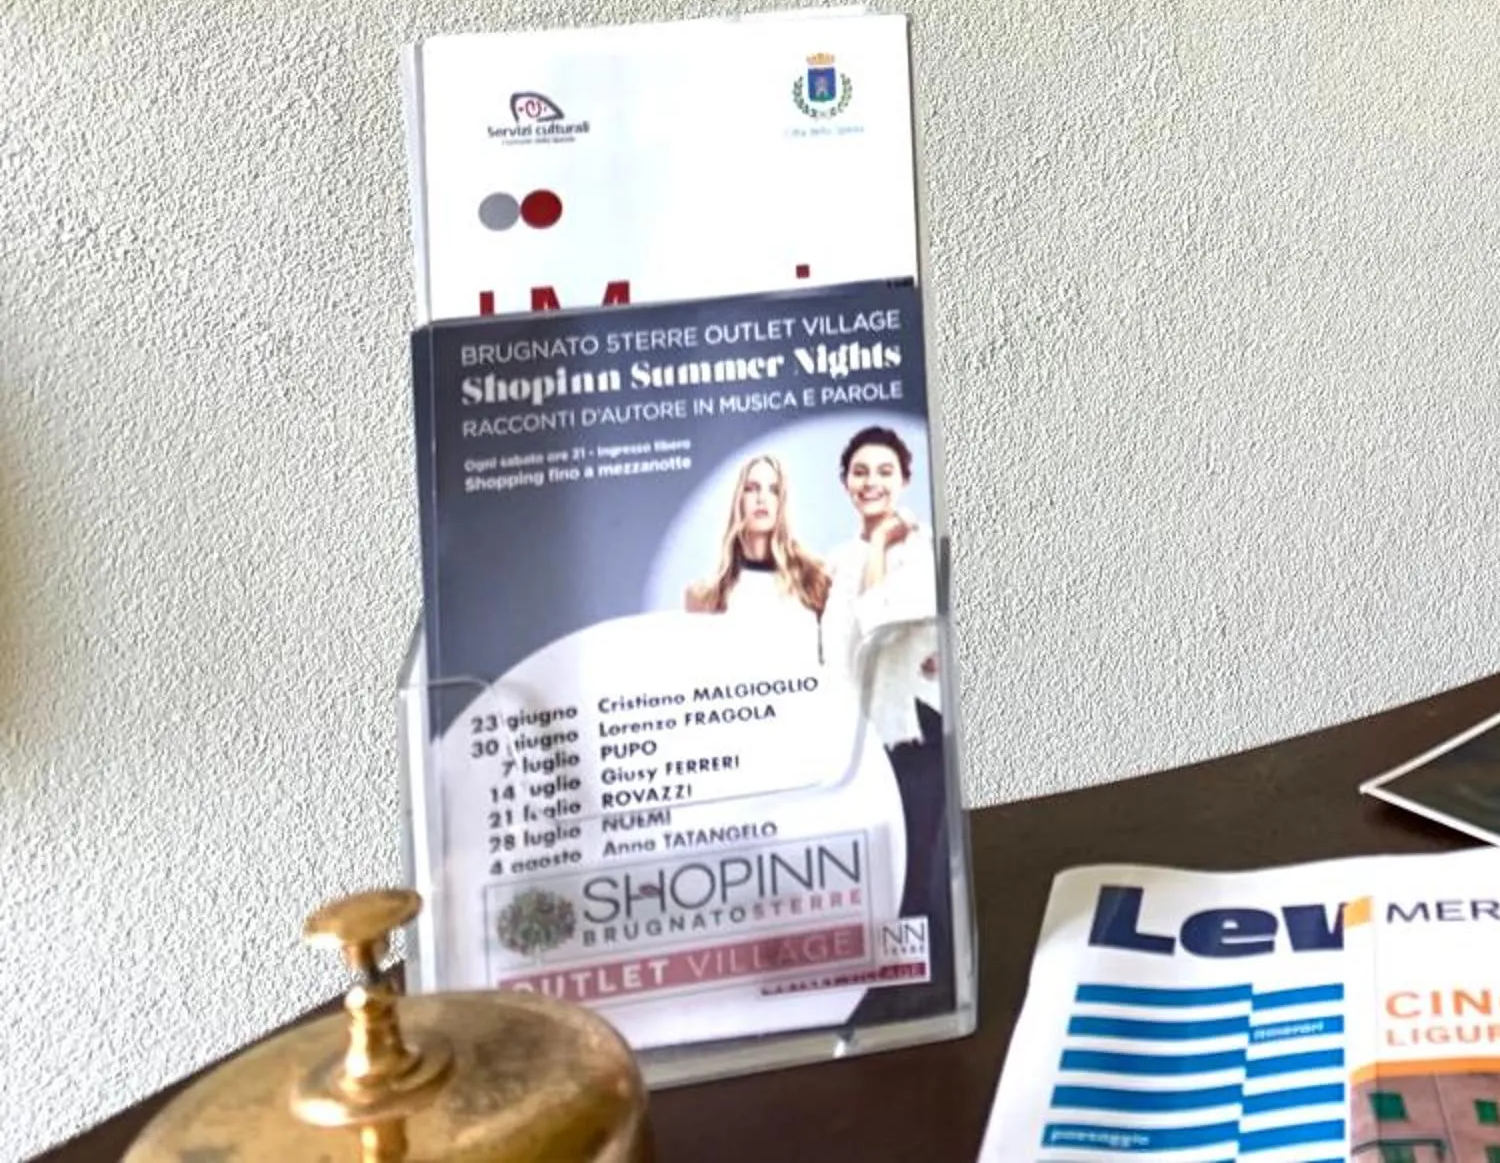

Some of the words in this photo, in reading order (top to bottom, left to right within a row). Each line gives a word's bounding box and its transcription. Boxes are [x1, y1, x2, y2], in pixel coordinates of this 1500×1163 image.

[461, 334, 599, 367] BRUGNATO
[607, 326, 698, 353] 5TERRE
[705, 317, 796, 345] OUTLET
[802, 309, 901, 337] VILLAGE
[461, 366, 621, 405] Shopinn
[630, 354, 785, 389] Summer
[794, 341, 902, 380] Nights
[463, 409, 575, 438] RACCONTI
[582, 399, 688, 427] D'AUTORE
[693, 396, 715, 416] IN
[720, 389, 798, 414] MUSICA
[803, 388, 816, 407] E
[821, 380, 903, 405] PAROLE
[547, 449, 569, 463] ore
[464, 470, 544, 494] Shopping
[548, 466, 580, 483] fino
[584, 467, 594, 479] a
[598, 456, 692, 477] mezzanotte
[598, 692, 686, 714] Cristiano
[693, 676, 819, 703] MALGIOGLIO
[471, 714, 499, 735] 23
[506, 706, 578, 731] giugno
[598, 718, 677, 738] Lorenzo
[684, 704, 776, 727] FRAGOLA
[471, 738, 499, 759] 30
[600, 739, 657, 761] PUPO
[502, 759, 515, 778] 7
[523, 751, 581, 775] luglio
[600, 767, 658, 786] Giusy
[665, 754, 740, 777] FERRERI
[490, 785, 515, 803] 14
[523, 774, 582, 798] uglio
[601, 783, 693, 810] ROVAZZI
[488, 808, 513, 829] 21
[523, 824, 582, 848] luglio
[663, 821, 778, 849] TATANGELO
[583, 840, 862, 925] SHOPINN
[688, 929, 853, 980] VILLAGE
